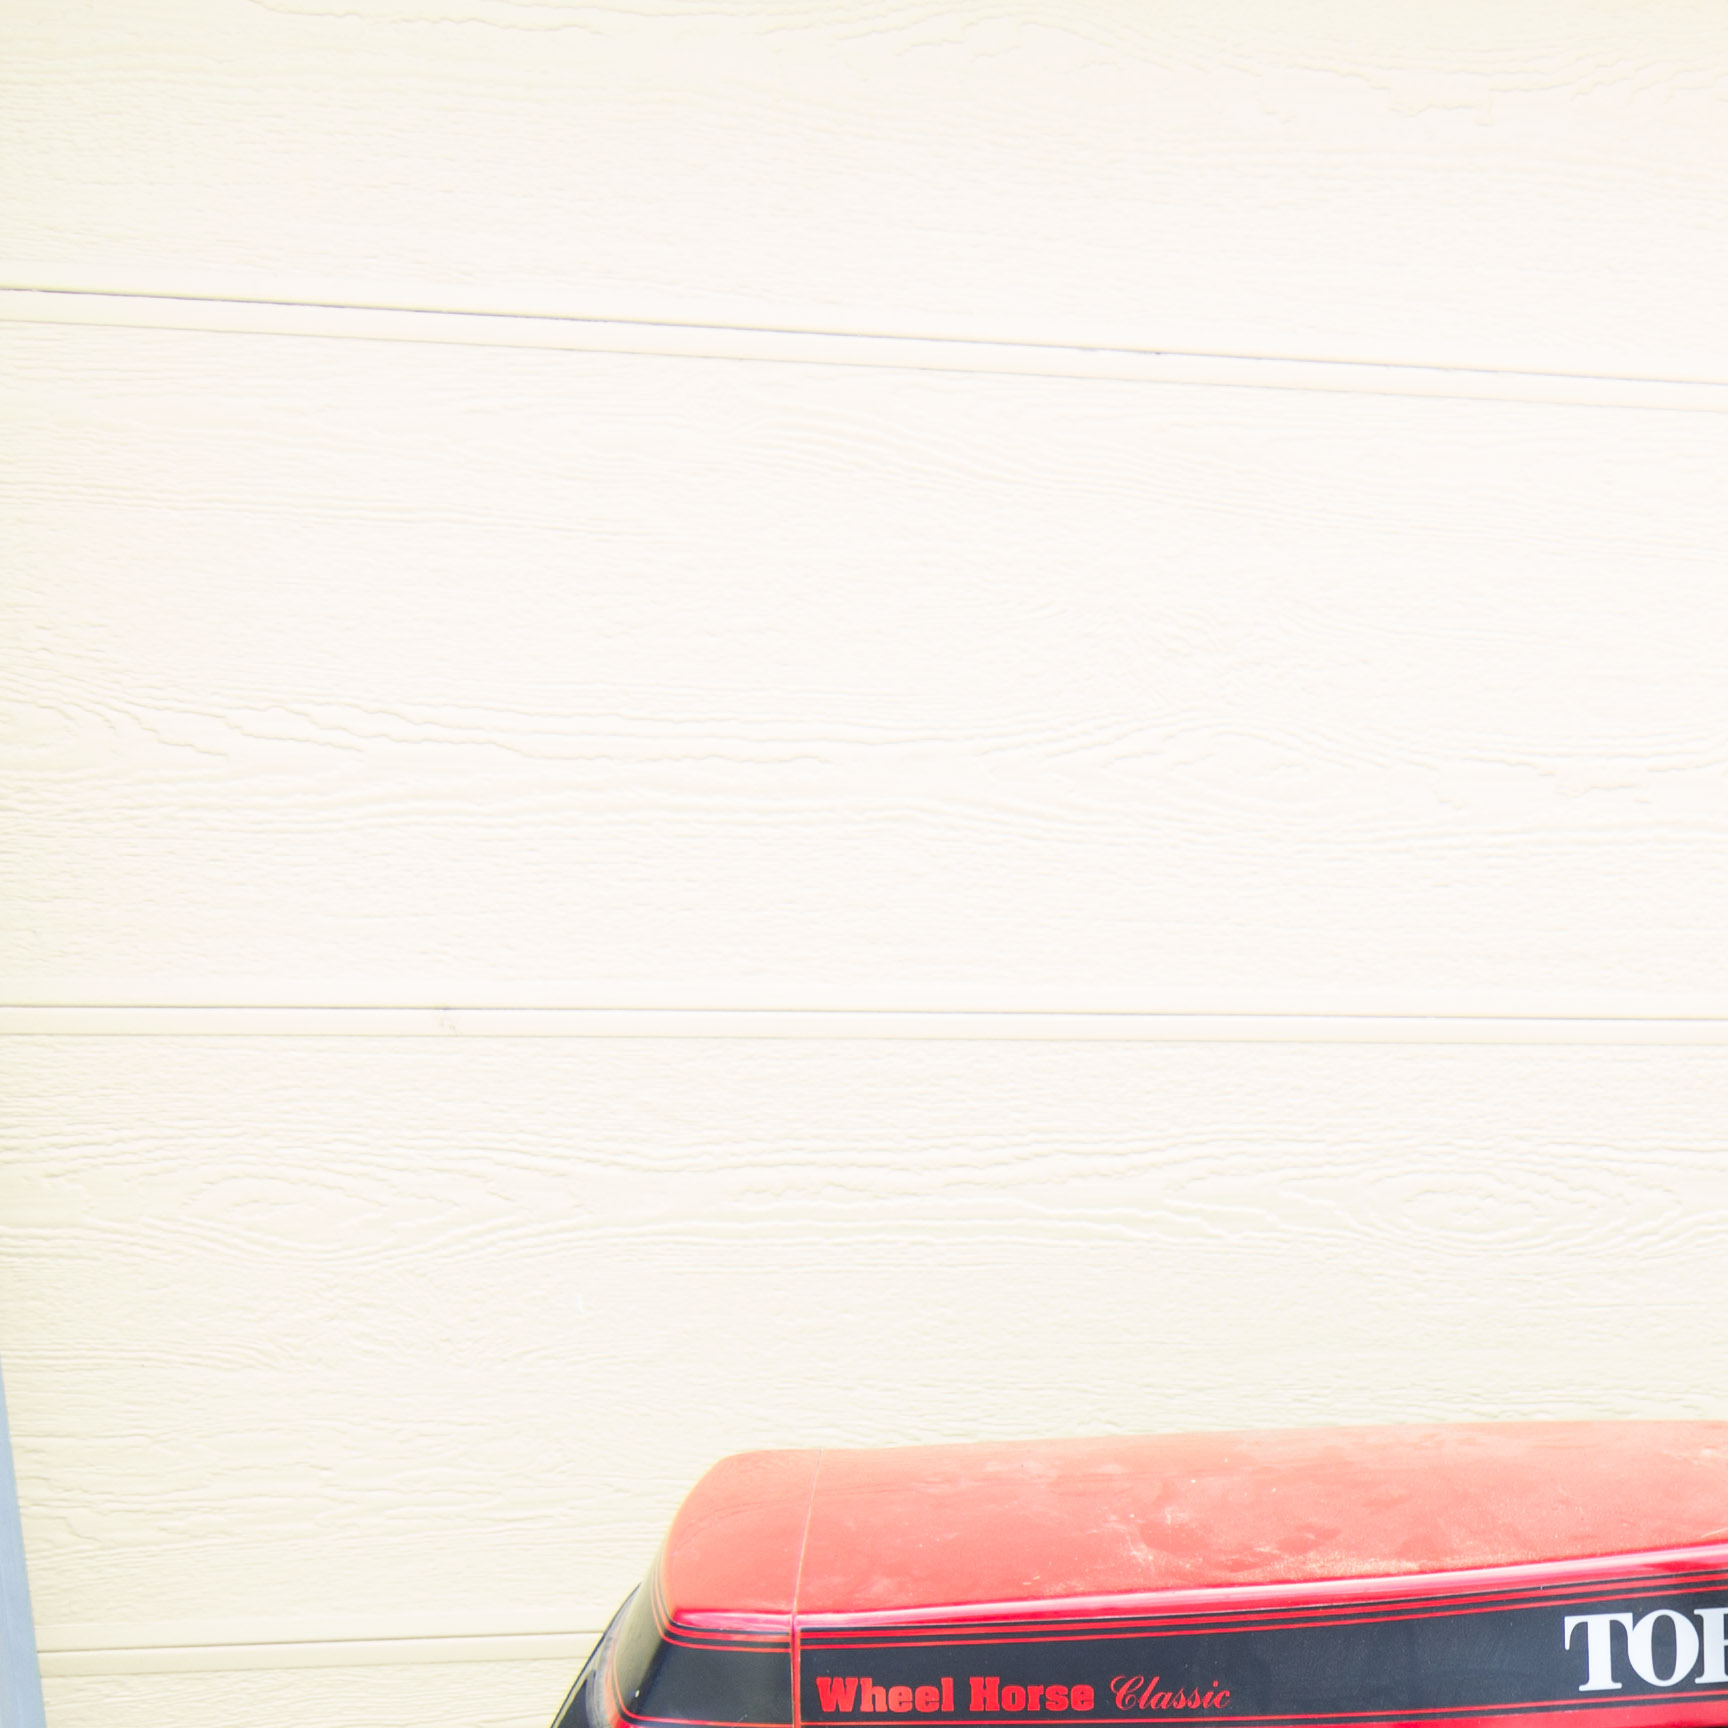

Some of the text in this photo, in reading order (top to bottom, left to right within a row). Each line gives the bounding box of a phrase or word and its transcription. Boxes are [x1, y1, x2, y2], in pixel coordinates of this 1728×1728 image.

[816, 1673, 1233, 1713] Wheel Horse Classic
